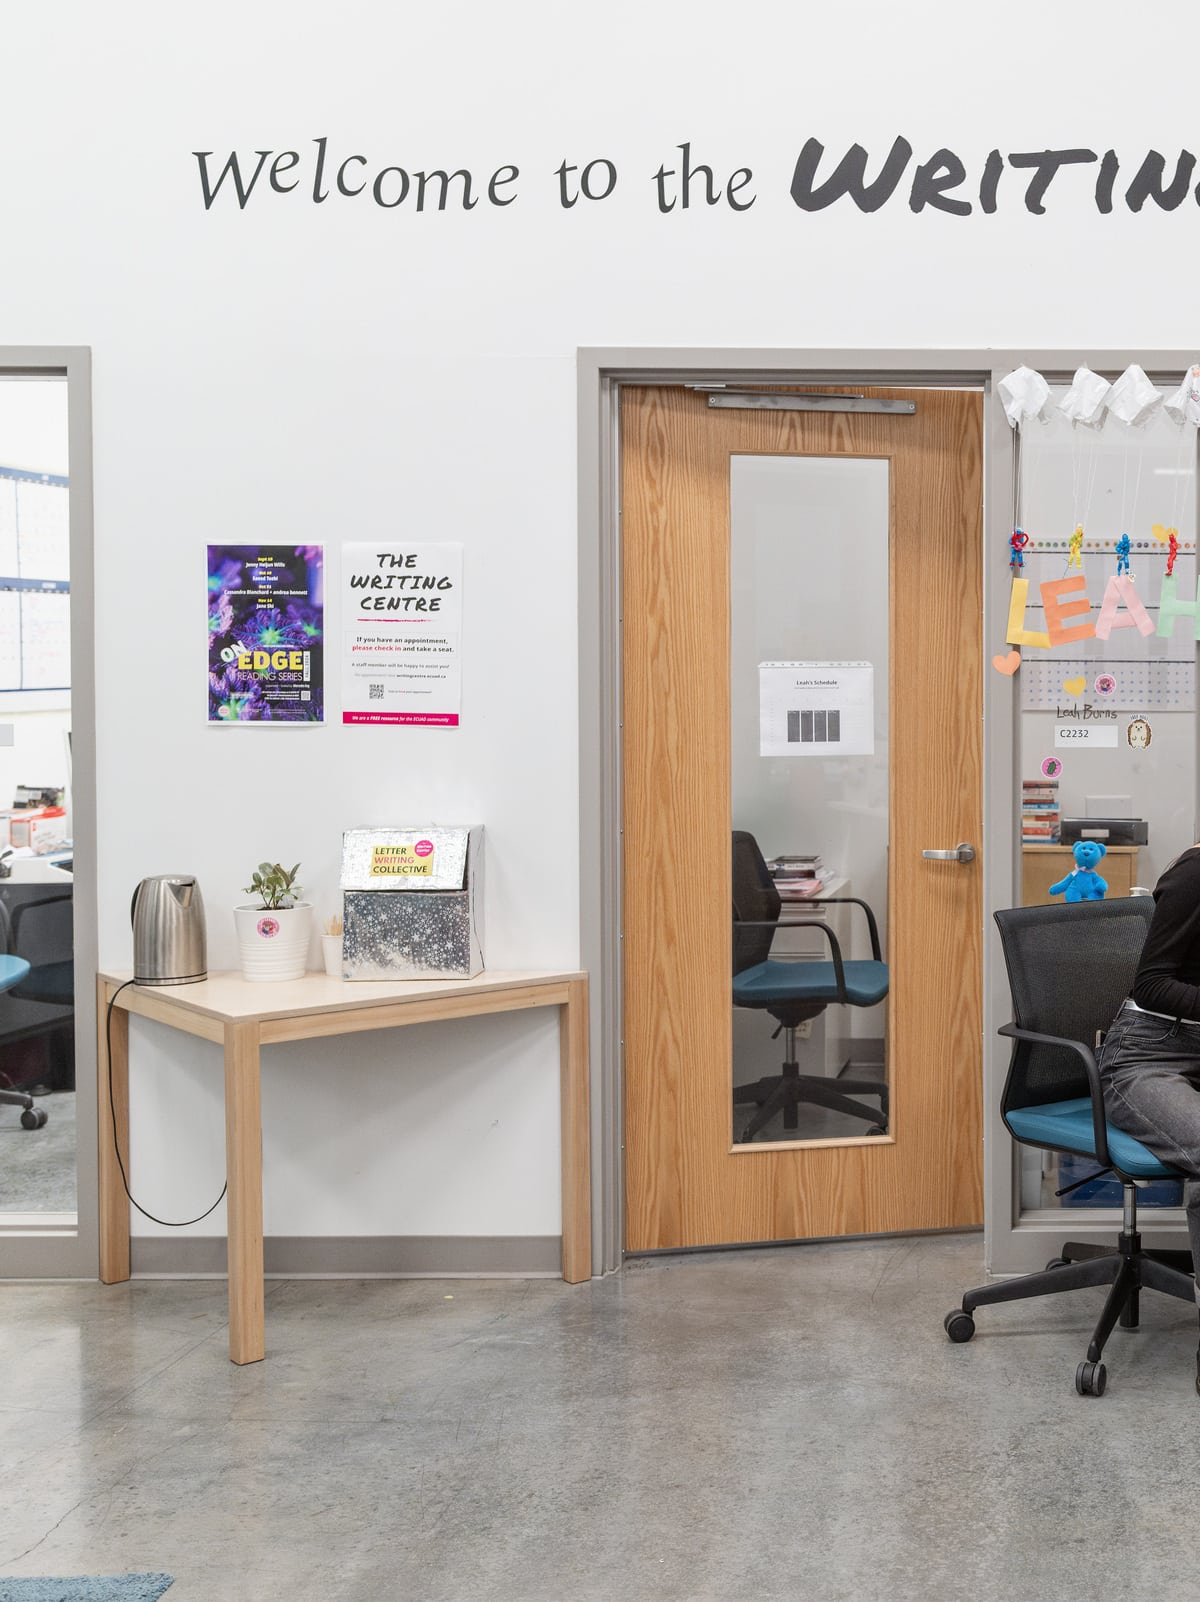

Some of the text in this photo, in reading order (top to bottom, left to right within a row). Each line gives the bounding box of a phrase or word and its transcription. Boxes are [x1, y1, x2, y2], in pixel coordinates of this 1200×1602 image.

[192, 137, 519, 211] Welcome
[554, 159, 617, 208] to
[652, 143, 756, 213] the
[377, 554, 417, 567] THE
[351, 575, 452, 590] WRITING
[361, 597, 441, 611] CENTRE
[403, 637, 448, 645] appointment,
[220, 641, 247, 663] ON
[238, 650, 303, 670] EDGE
[237, 671, 303, 681] READING SERIES
[1057, 704, 1080, 719] Leah
[1083, 704, 1118, 720] Burns
[1060, 729, 1089, 738] C2232
[375, 847, 407, 855] LETTER
[374, 856, 414, 864] WRITING
[373, 865, 428, 874] COLLECTIVE
